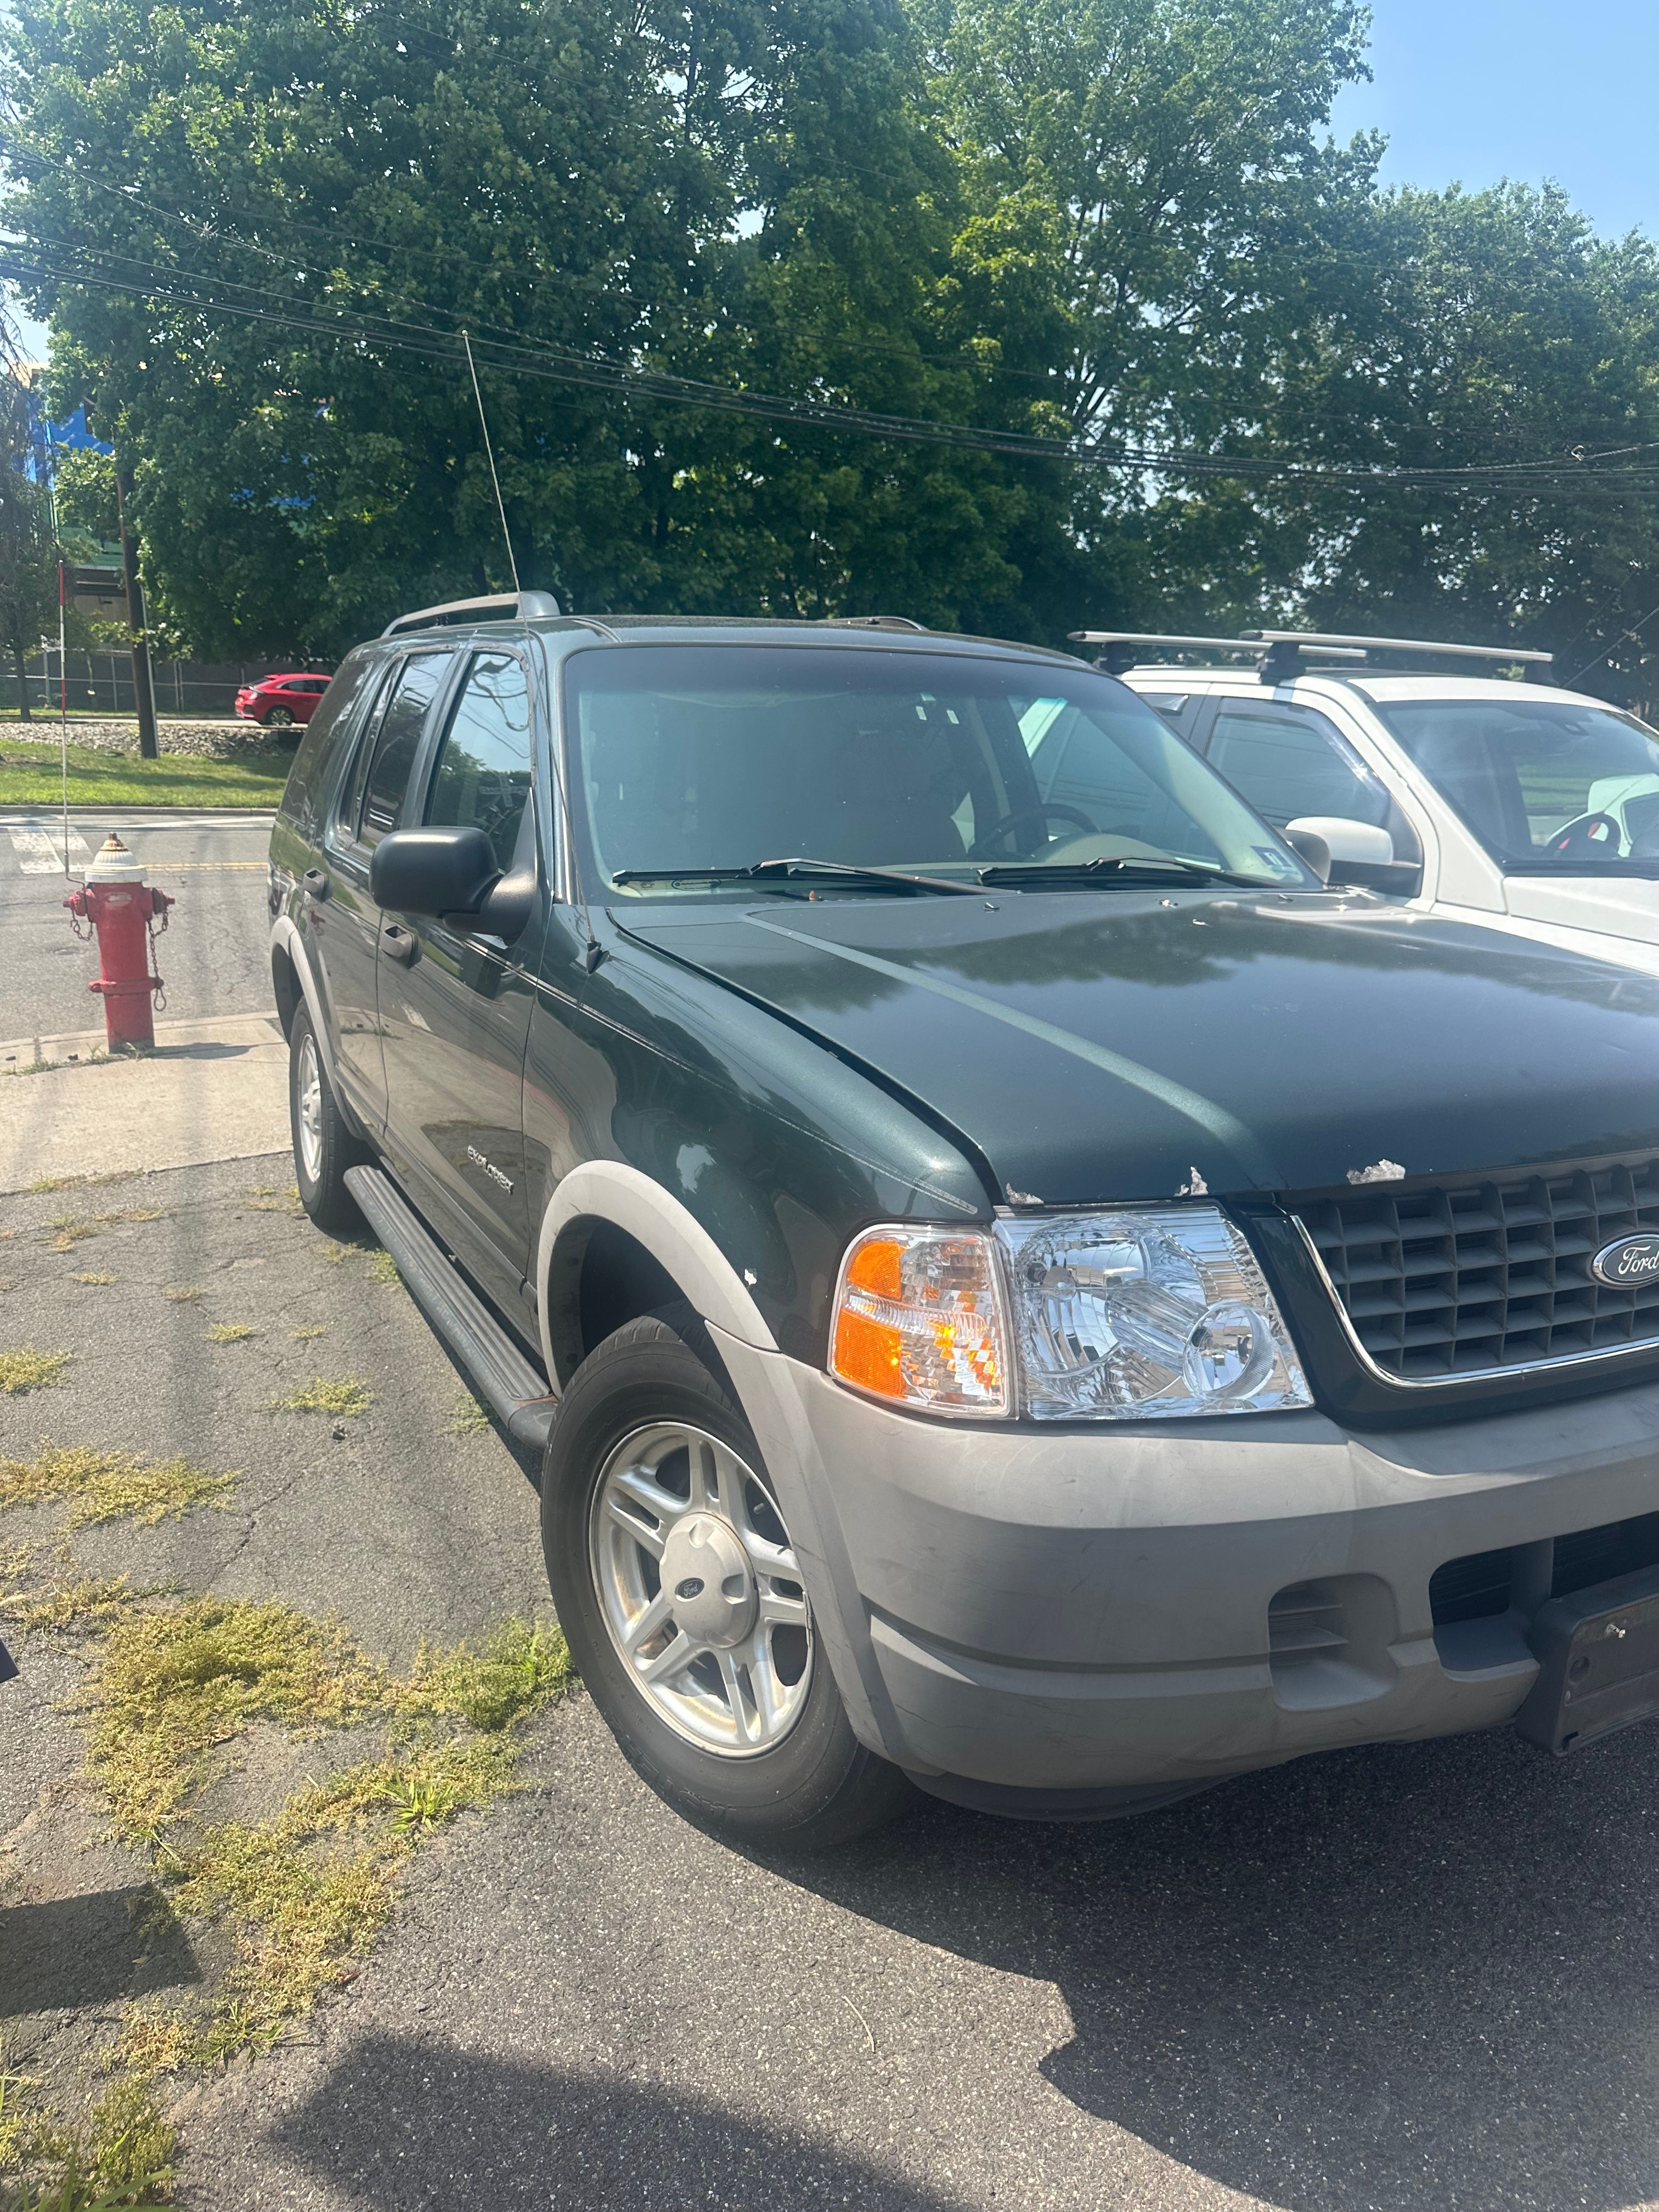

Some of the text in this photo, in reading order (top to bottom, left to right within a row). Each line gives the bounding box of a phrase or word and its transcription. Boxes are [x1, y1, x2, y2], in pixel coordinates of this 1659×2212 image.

[467, 1145, 514, 1195] EXPLORER
[1618, 1245, 1659, 1275] Ford
[684, 1583, 698, 1596] Ford
